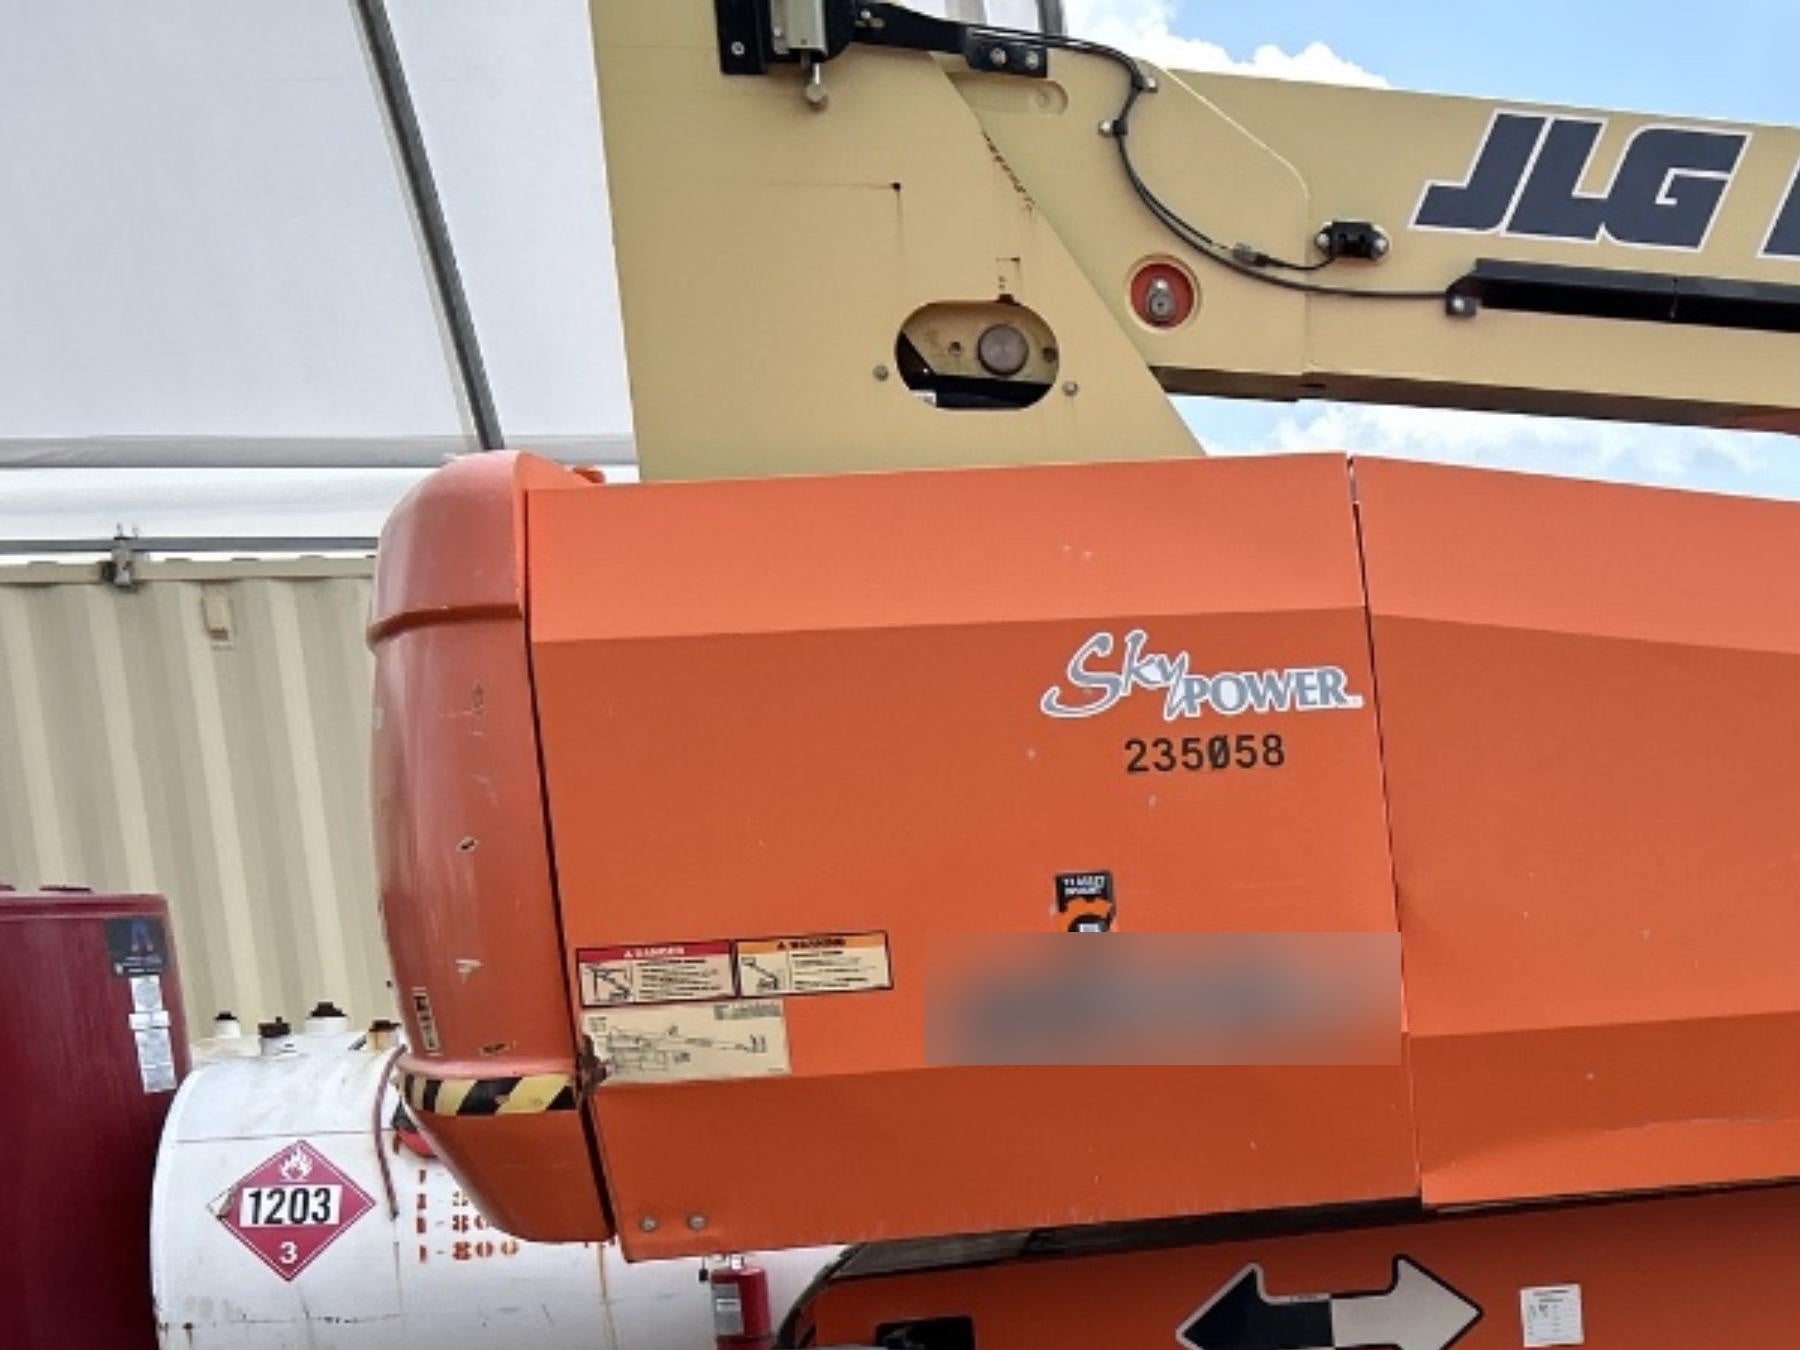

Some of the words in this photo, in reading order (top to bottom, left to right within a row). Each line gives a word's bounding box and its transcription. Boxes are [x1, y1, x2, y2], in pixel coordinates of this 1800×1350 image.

[1408, 108, 1754, 254] JLG
[1123, 733, 1286, 775] 235058
[247, 1186, 333, 1225] 1203
[278, 1241, 298, 1265] 3
